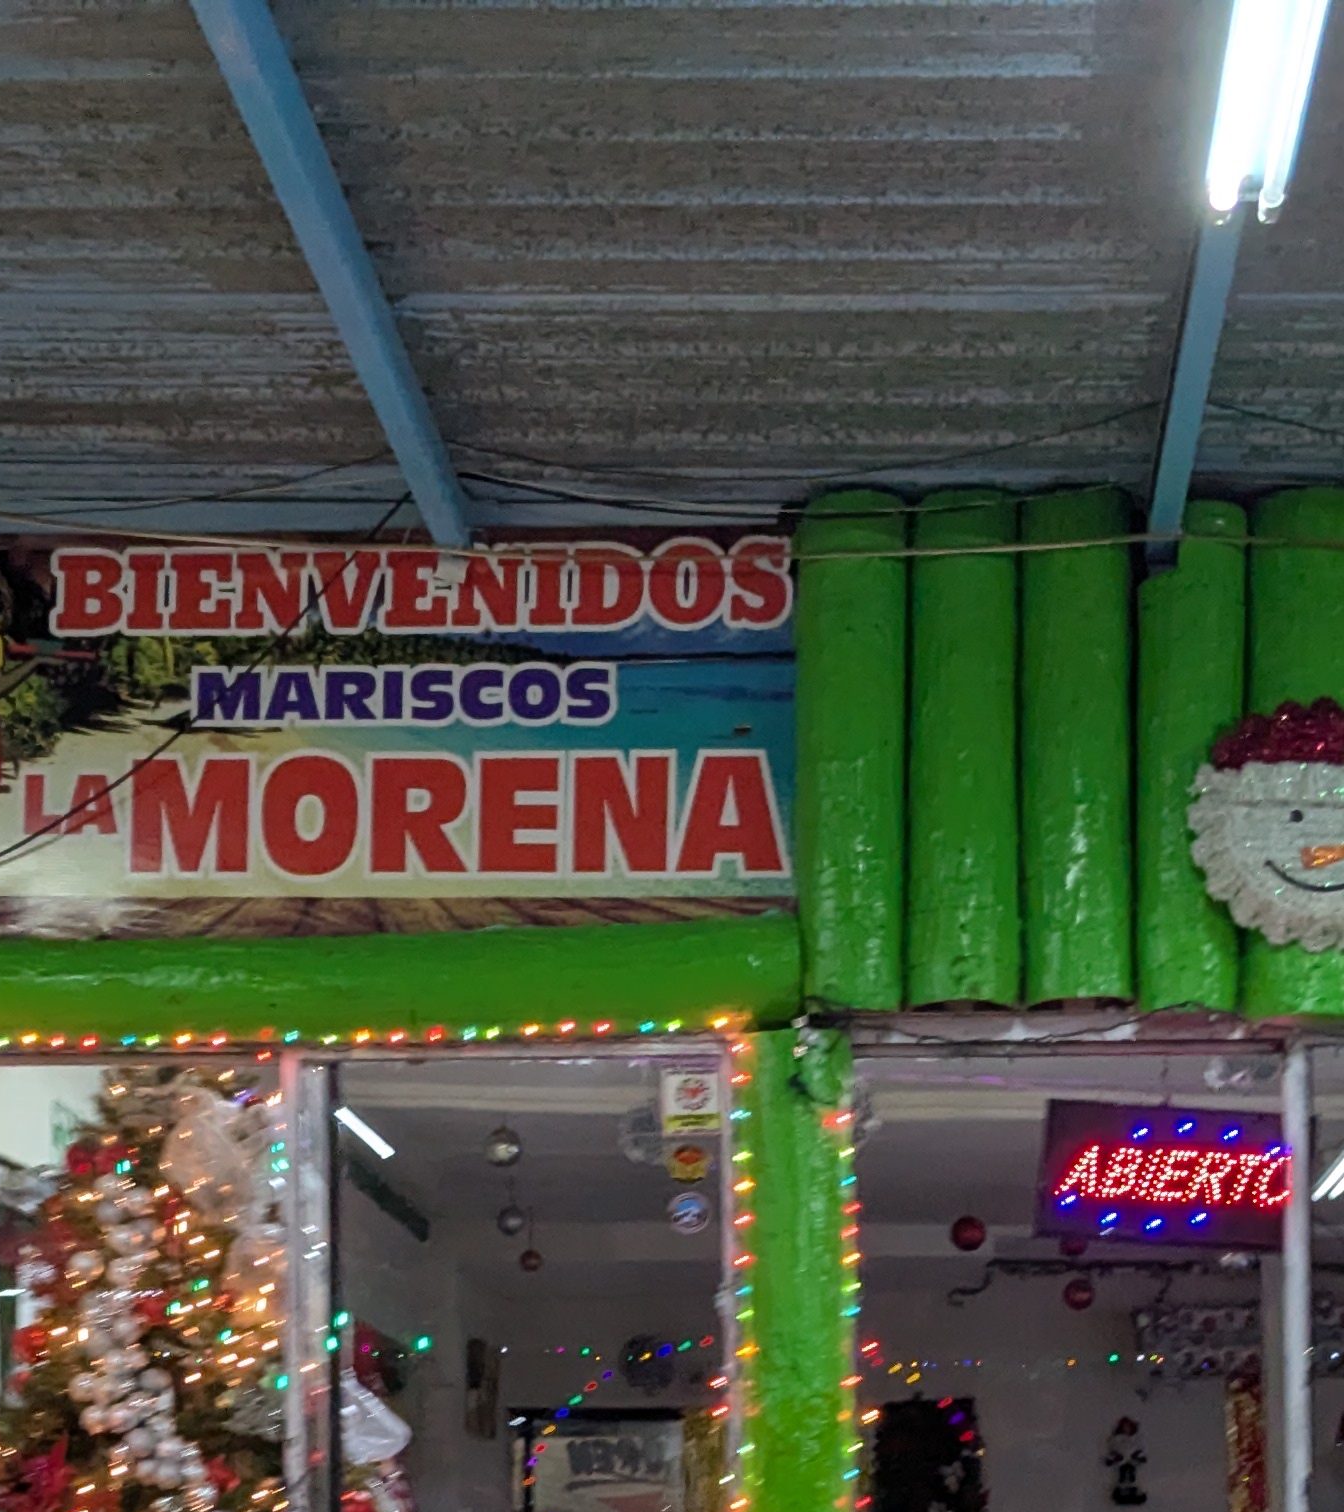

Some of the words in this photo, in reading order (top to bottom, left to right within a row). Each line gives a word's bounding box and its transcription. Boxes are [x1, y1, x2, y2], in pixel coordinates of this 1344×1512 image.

[54, 540, 792, 633] BIENVENIDOS
[197, 668, 612, 721] MARISCOS
[23, 773, 117, 836] LA
[128, 755, 788, 875] MORENA
[1054, 1144, 1294, 1208] ABIERTO
